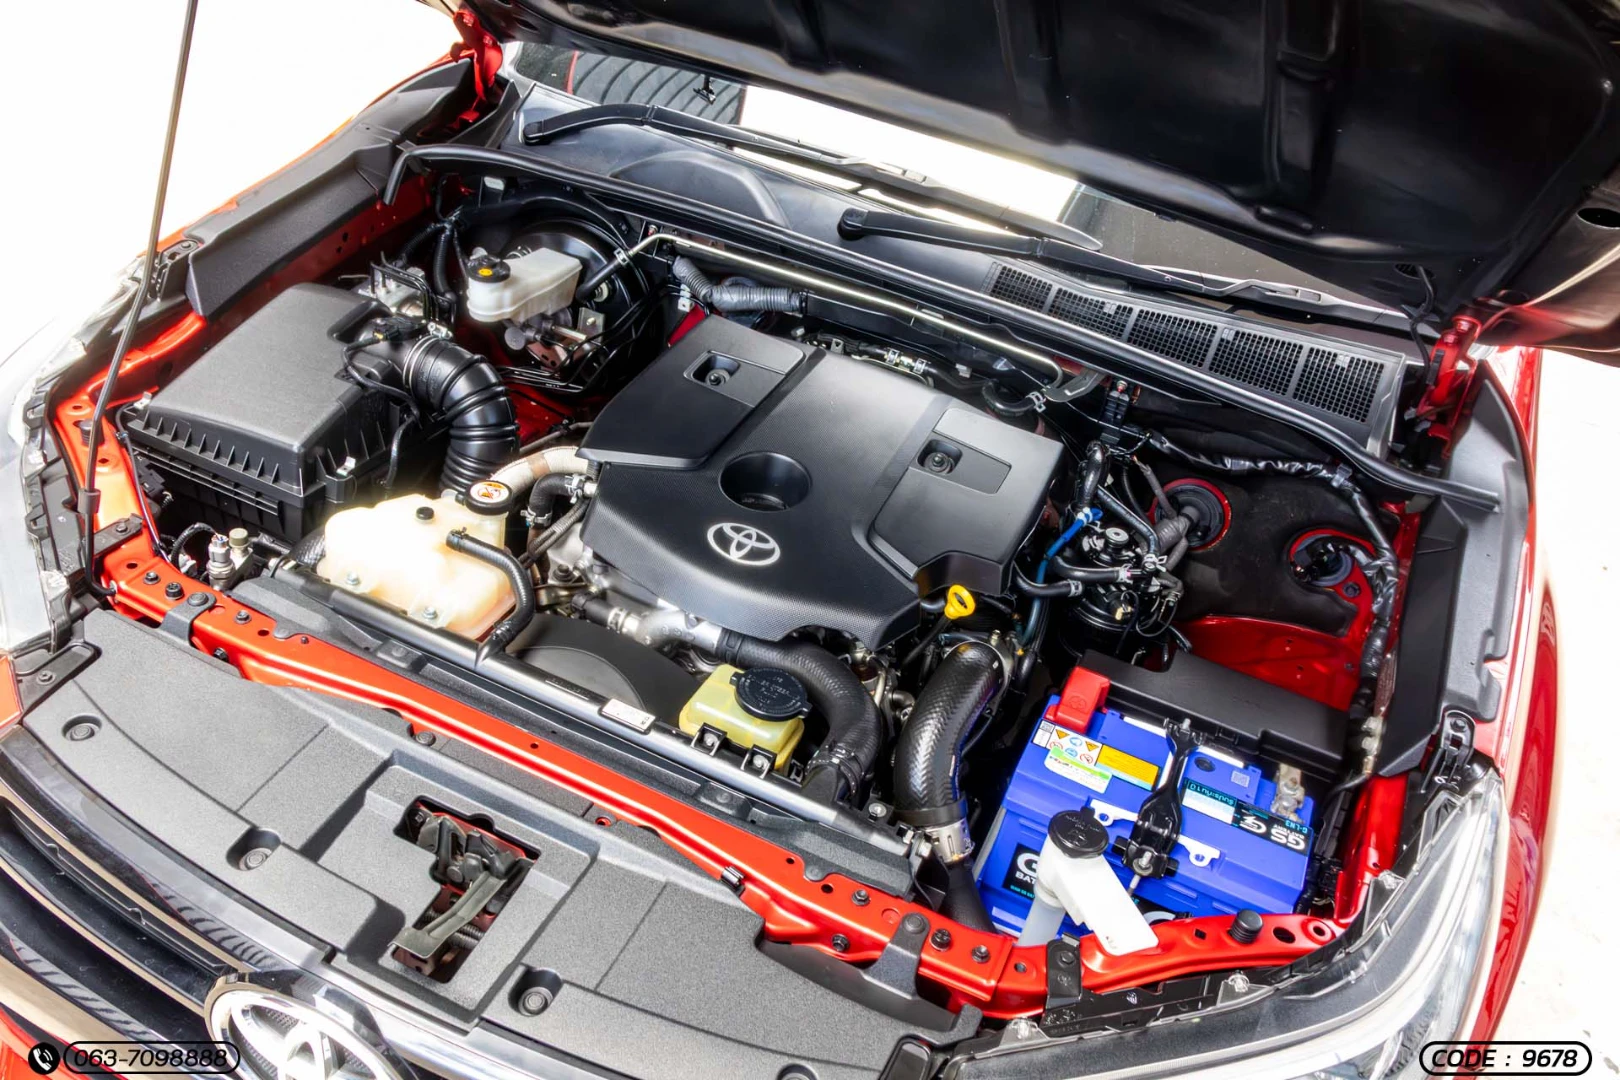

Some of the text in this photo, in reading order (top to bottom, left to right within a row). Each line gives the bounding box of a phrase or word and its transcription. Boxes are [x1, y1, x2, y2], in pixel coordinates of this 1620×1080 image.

[1285, 820, 1308, 834] G-LN3
[1270, 828, 1306, 850] GS
[1017, 853, 1040, 878] G
[1015, 871, 1037, 885] BAT
